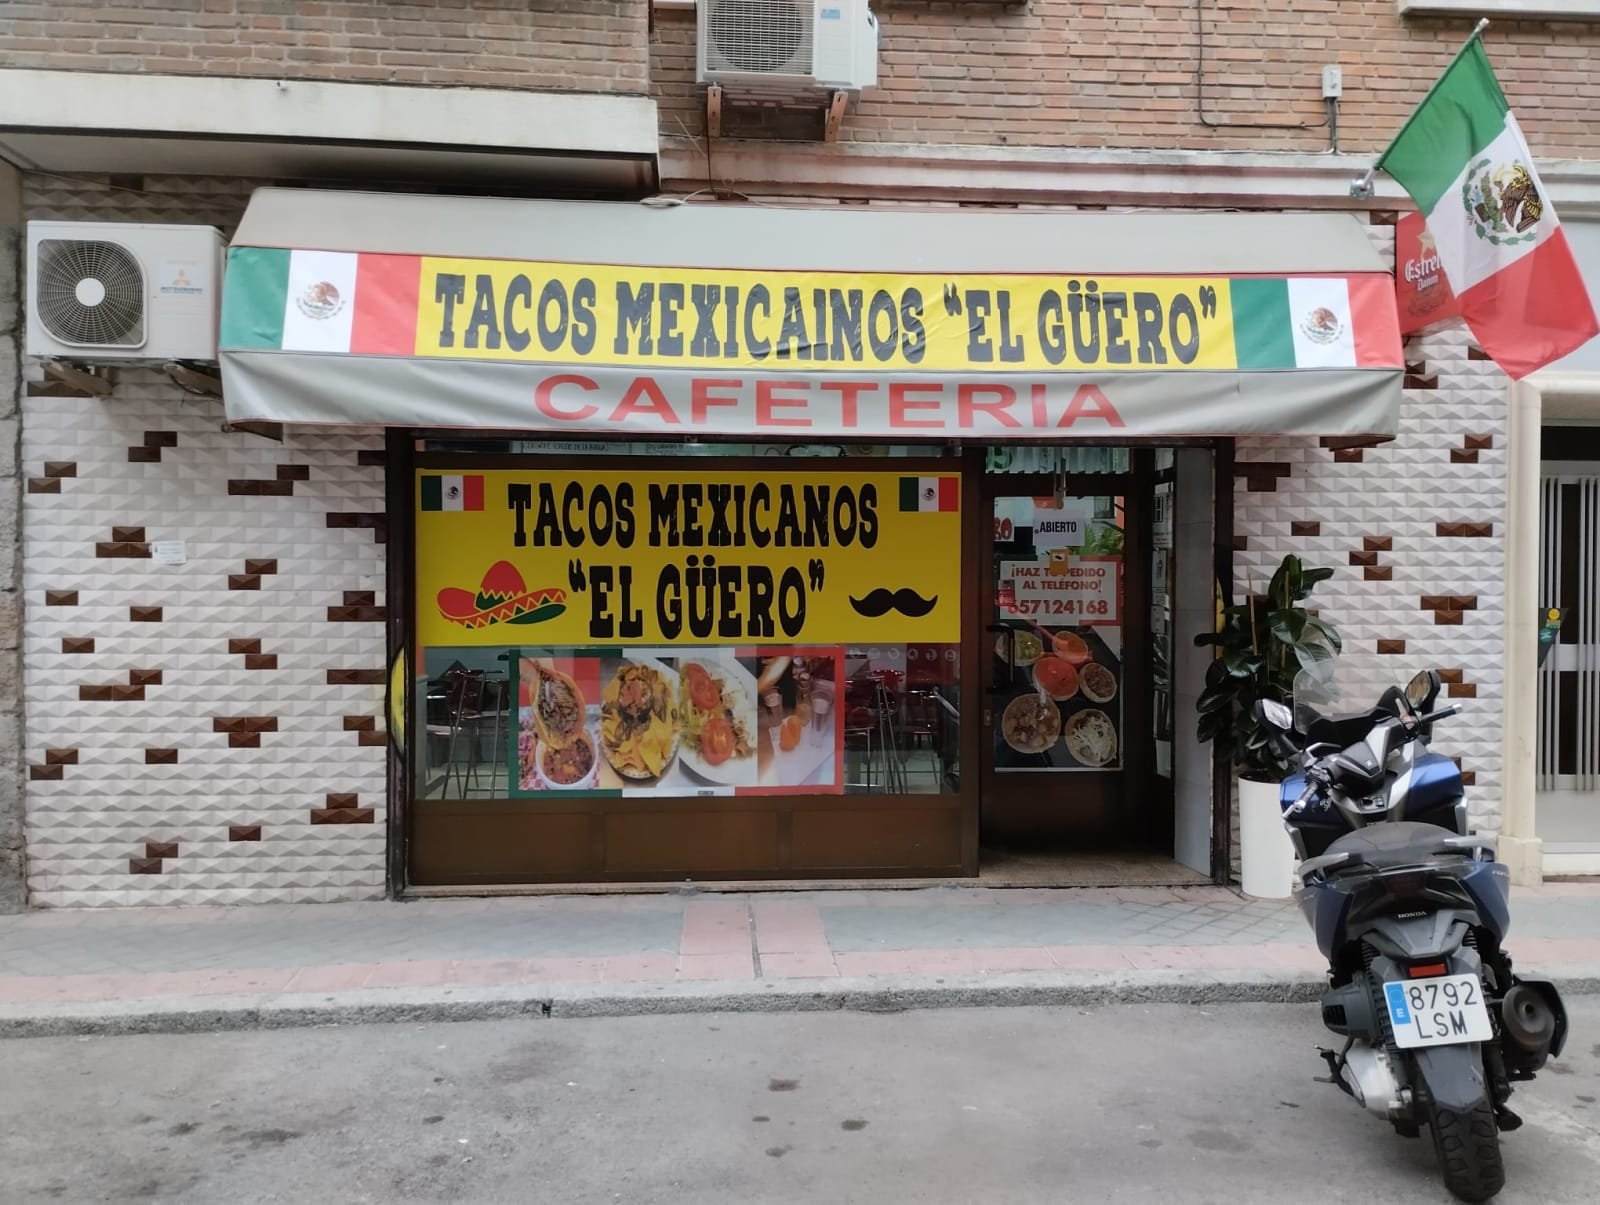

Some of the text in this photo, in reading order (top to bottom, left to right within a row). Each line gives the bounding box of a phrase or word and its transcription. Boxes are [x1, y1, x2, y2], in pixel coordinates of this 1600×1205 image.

[1405, 256, 1440, 281] Estrel
[435, 273, 597, 356] TACOS
[613, 280, 925, 364] MEXICAINOS
[534, 374, 1127, 429] CAFETERIA
[508, 481, 879, 549] TACOS MEXICANOS
[1039, 521, 1077, 533] ABIERTO
[1022, 581, 1037, 590] AL
[1398, 911, 1427, 919] HONDA
[1409, 981, 1478, 1011] 8792
[1396, 1008, 1405, 1018] E
[1414, 1010, 1468, 1039] LSM
